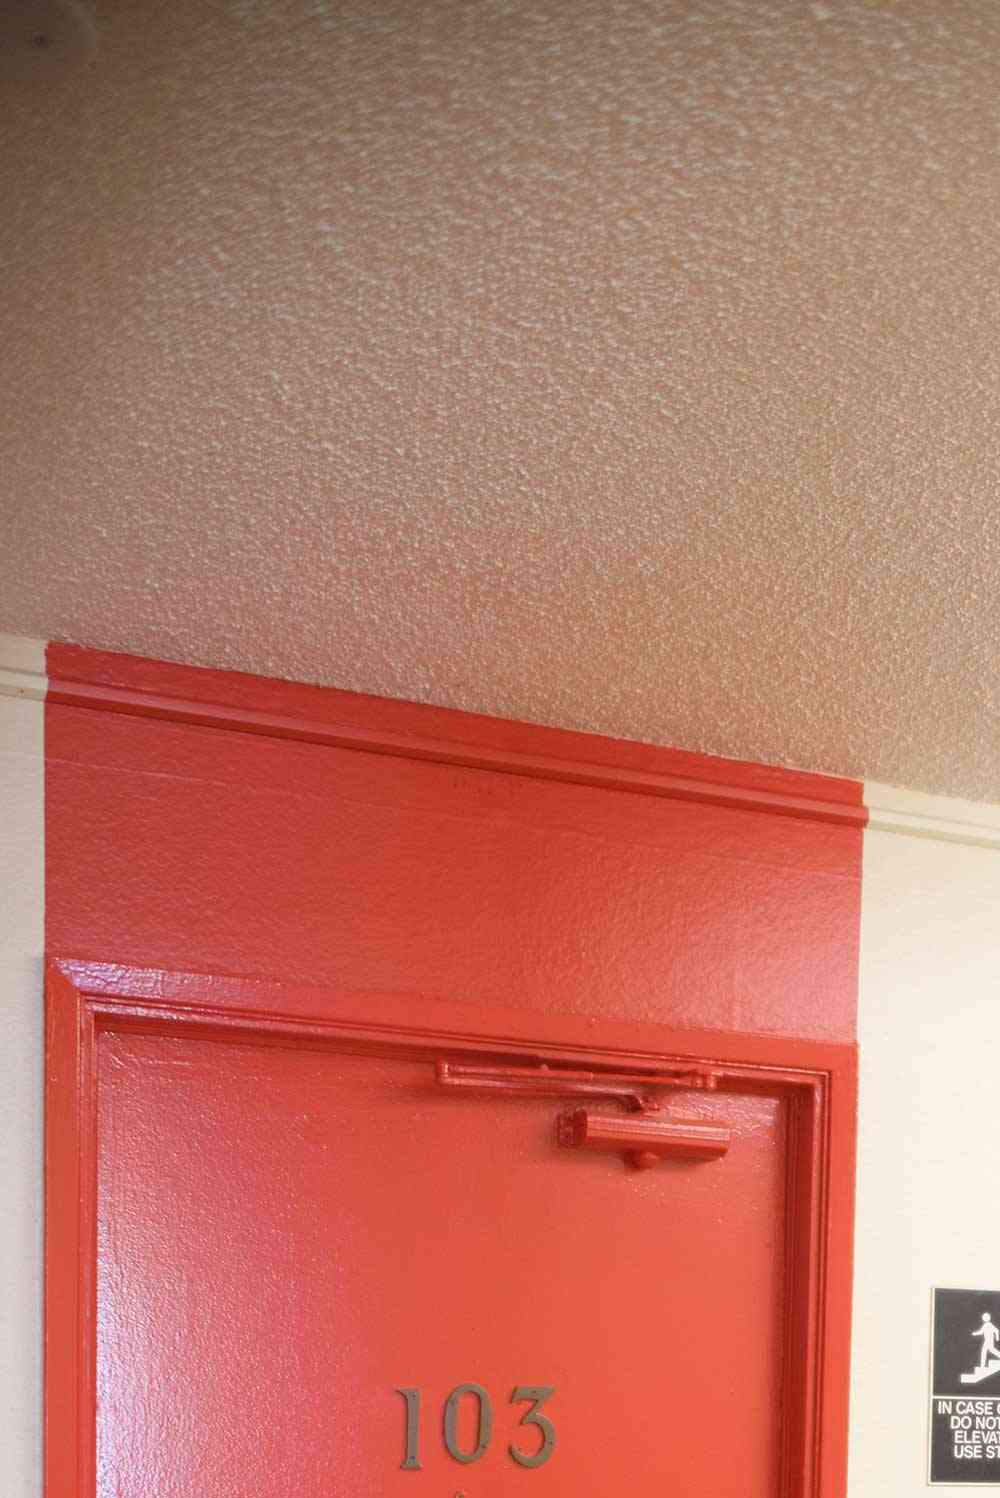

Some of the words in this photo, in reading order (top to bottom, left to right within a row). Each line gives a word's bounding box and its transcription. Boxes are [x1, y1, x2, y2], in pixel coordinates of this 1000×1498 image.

[938, 1401, 952, 1414] IN
[956, 1401, 993, 1415] CASE
[395, 1383, 556, 1470] 103
[950, 1416, 972, 1429] DO
[954, 1445, 983, 1459] USE
